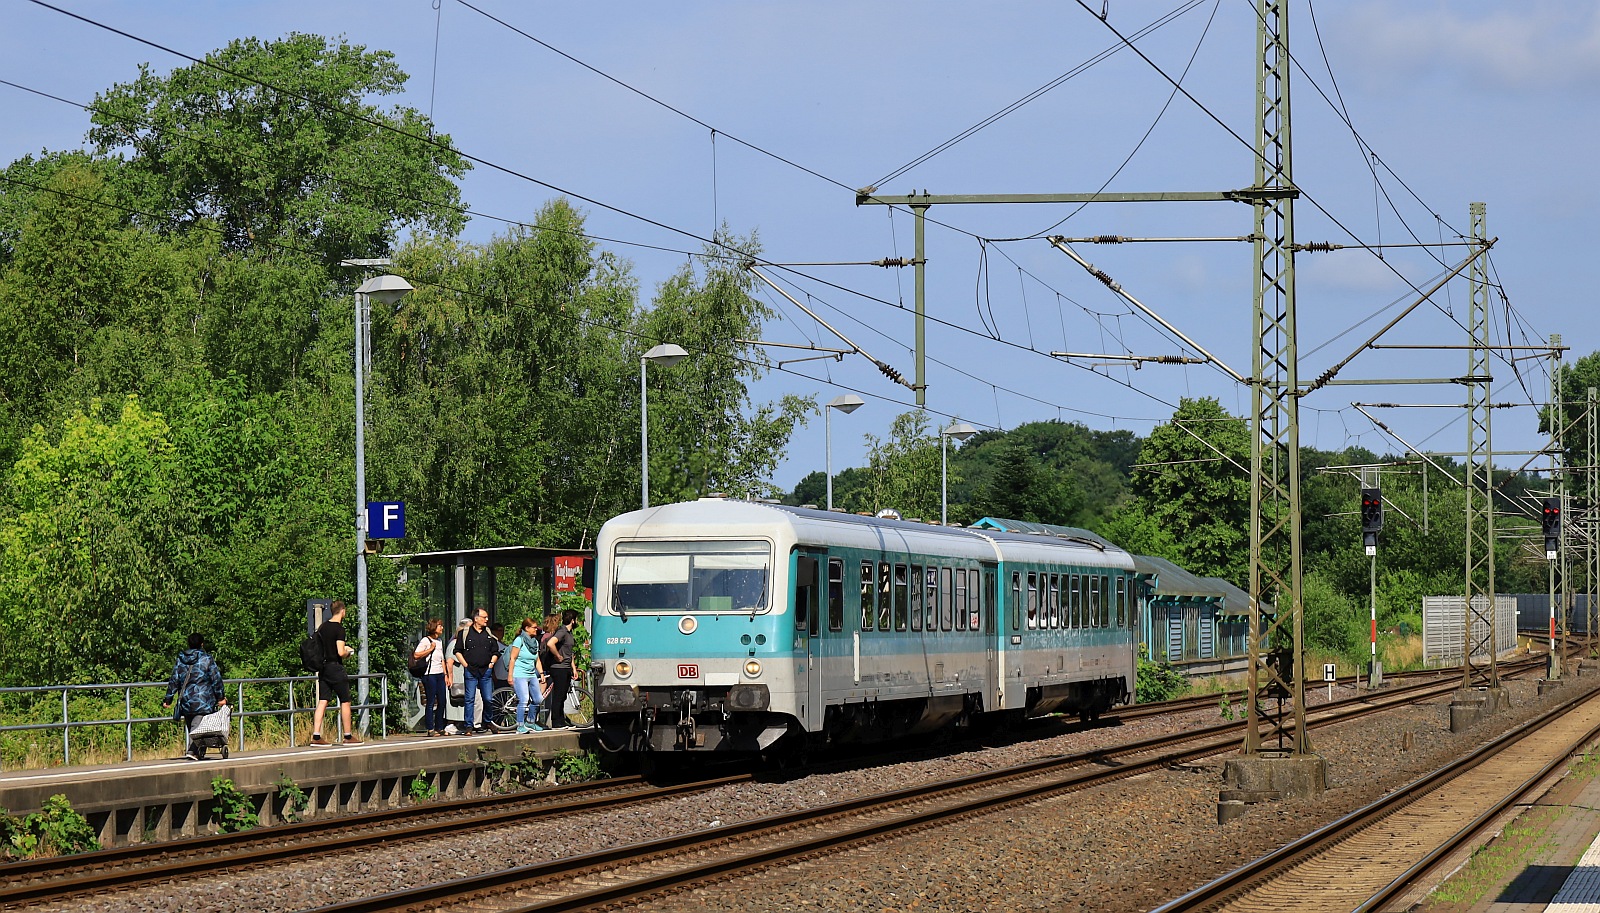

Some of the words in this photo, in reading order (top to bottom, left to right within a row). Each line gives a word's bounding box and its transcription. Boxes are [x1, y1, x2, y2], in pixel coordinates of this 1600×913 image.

[383, 504, 399, 531] F
[606, 637, 619, 645] 628
[679, 666, 697, 677] DB
[1325, 665, 1335, 680] H
